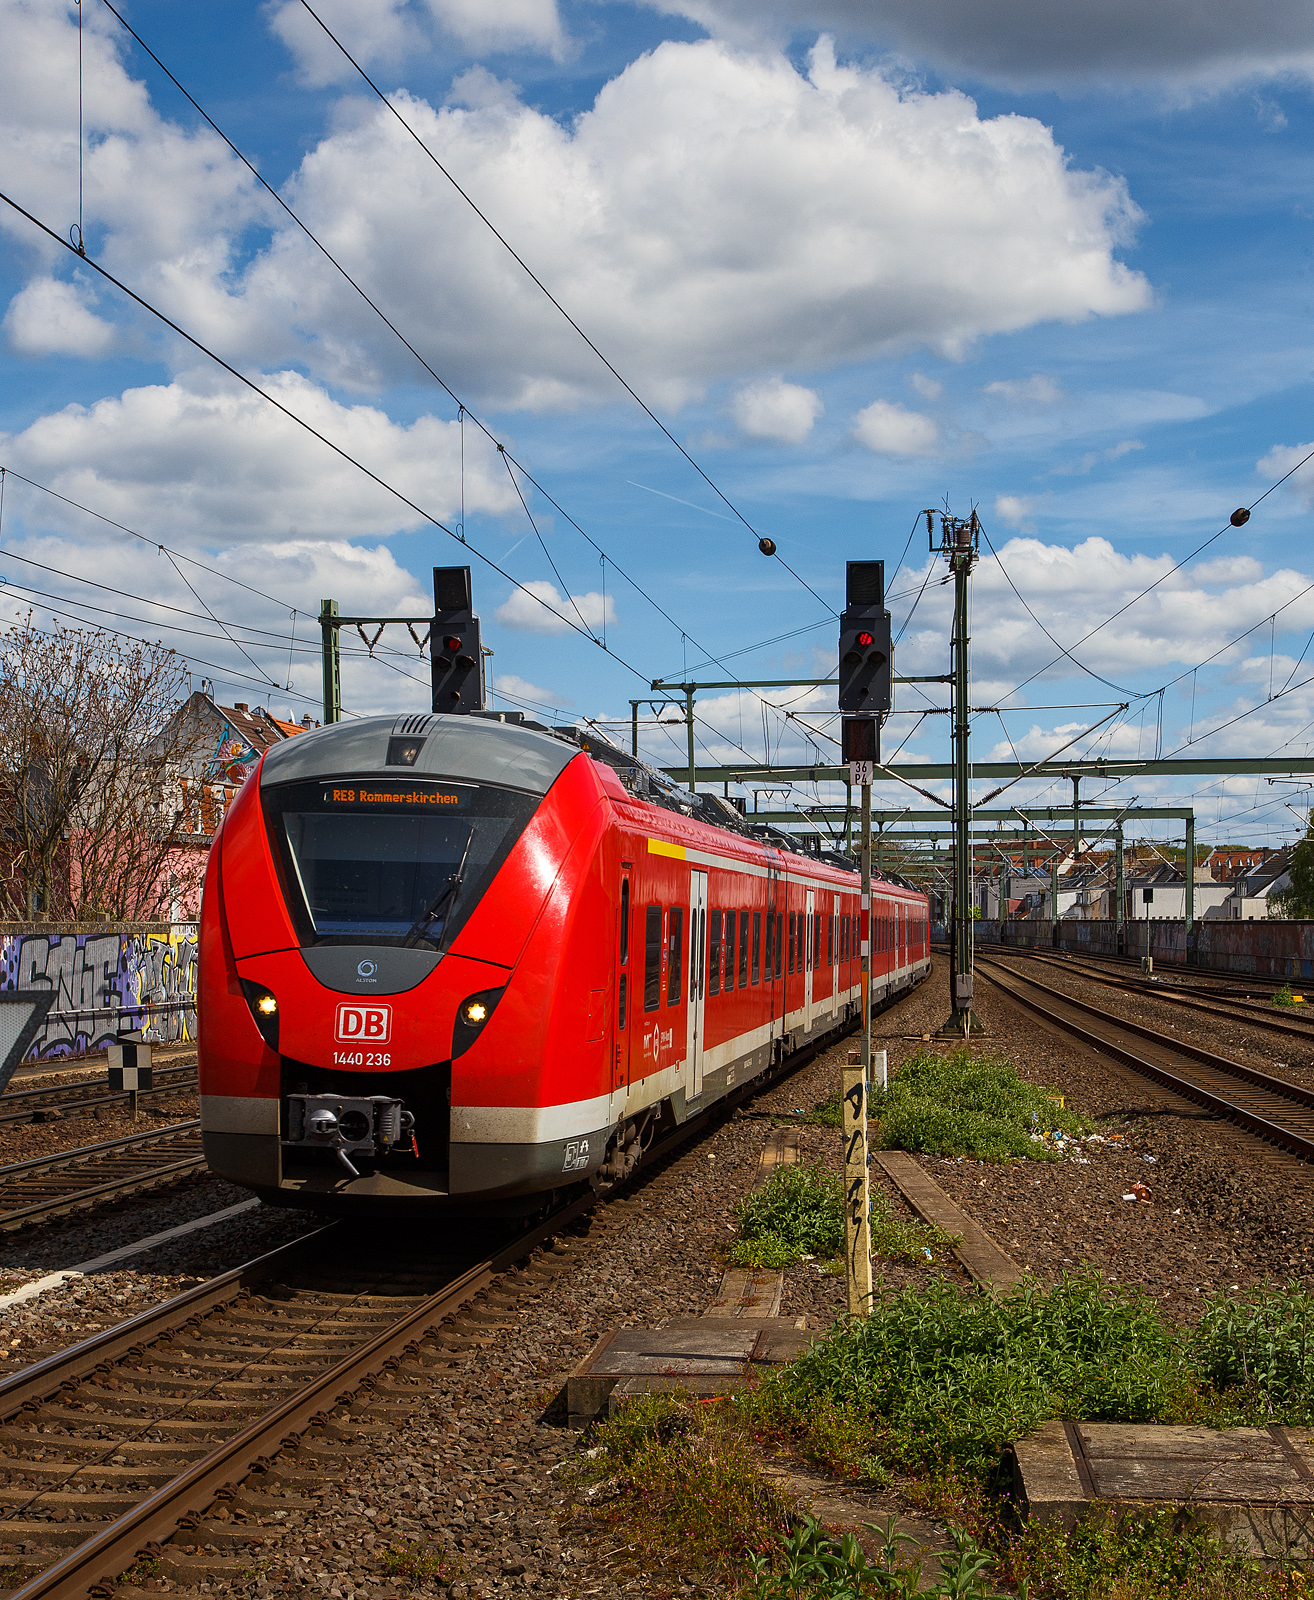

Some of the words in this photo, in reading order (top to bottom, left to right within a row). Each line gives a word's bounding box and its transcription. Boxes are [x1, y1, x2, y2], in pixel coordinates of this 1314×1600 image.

[855, 761, 867, 773] 36
[855, 773, 867, 785] P4
[333, 789, 355, 802] RE8
[359, 790, 458, 804] Rommerskirchen
[341, 1009, 386, 1038] DB
[333, 1051, 363, 1066] 1440
[366, 1053, 391, 1066] 236
